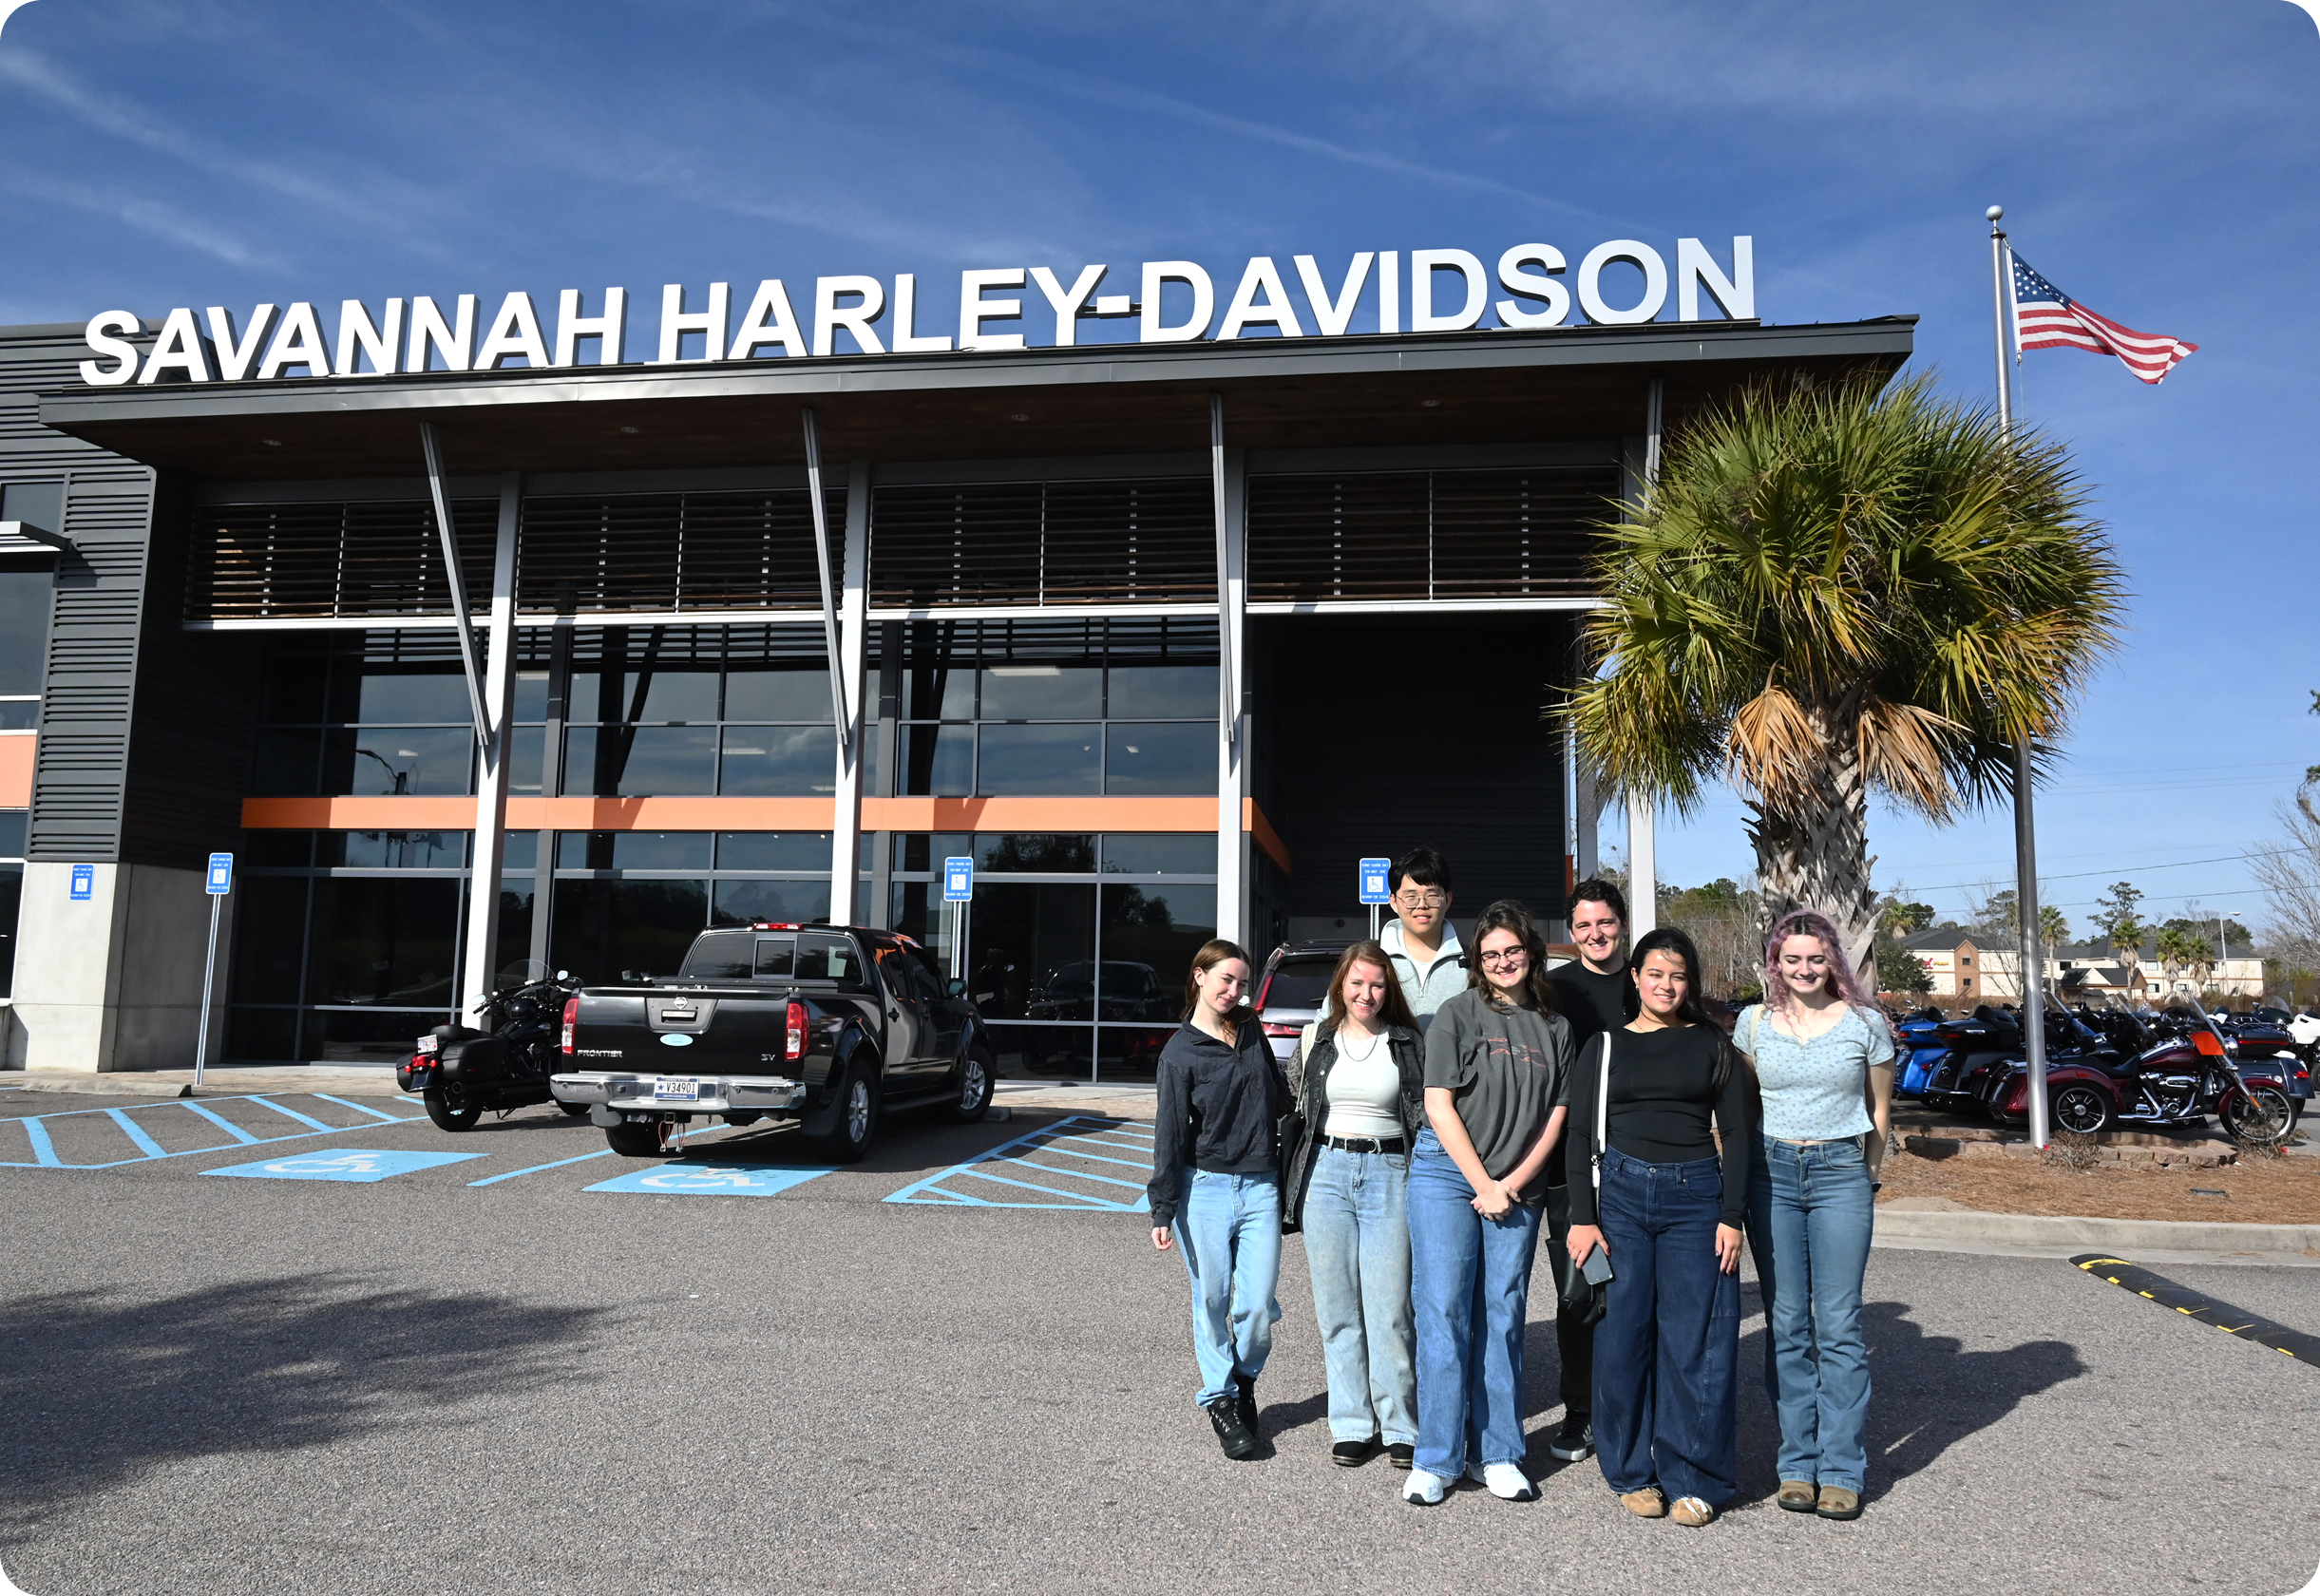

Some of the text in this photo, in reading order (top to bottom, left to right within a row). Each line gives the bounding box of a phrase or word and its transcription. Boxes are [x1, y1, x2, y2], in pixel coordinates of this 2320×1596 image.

[78, 235, 1757, 386] SAVANNAH HARLEY-DAVIDSON
[577, 1049, 622, 1057] FRONTIER
[666, 1082, 695, 1093] V34901
